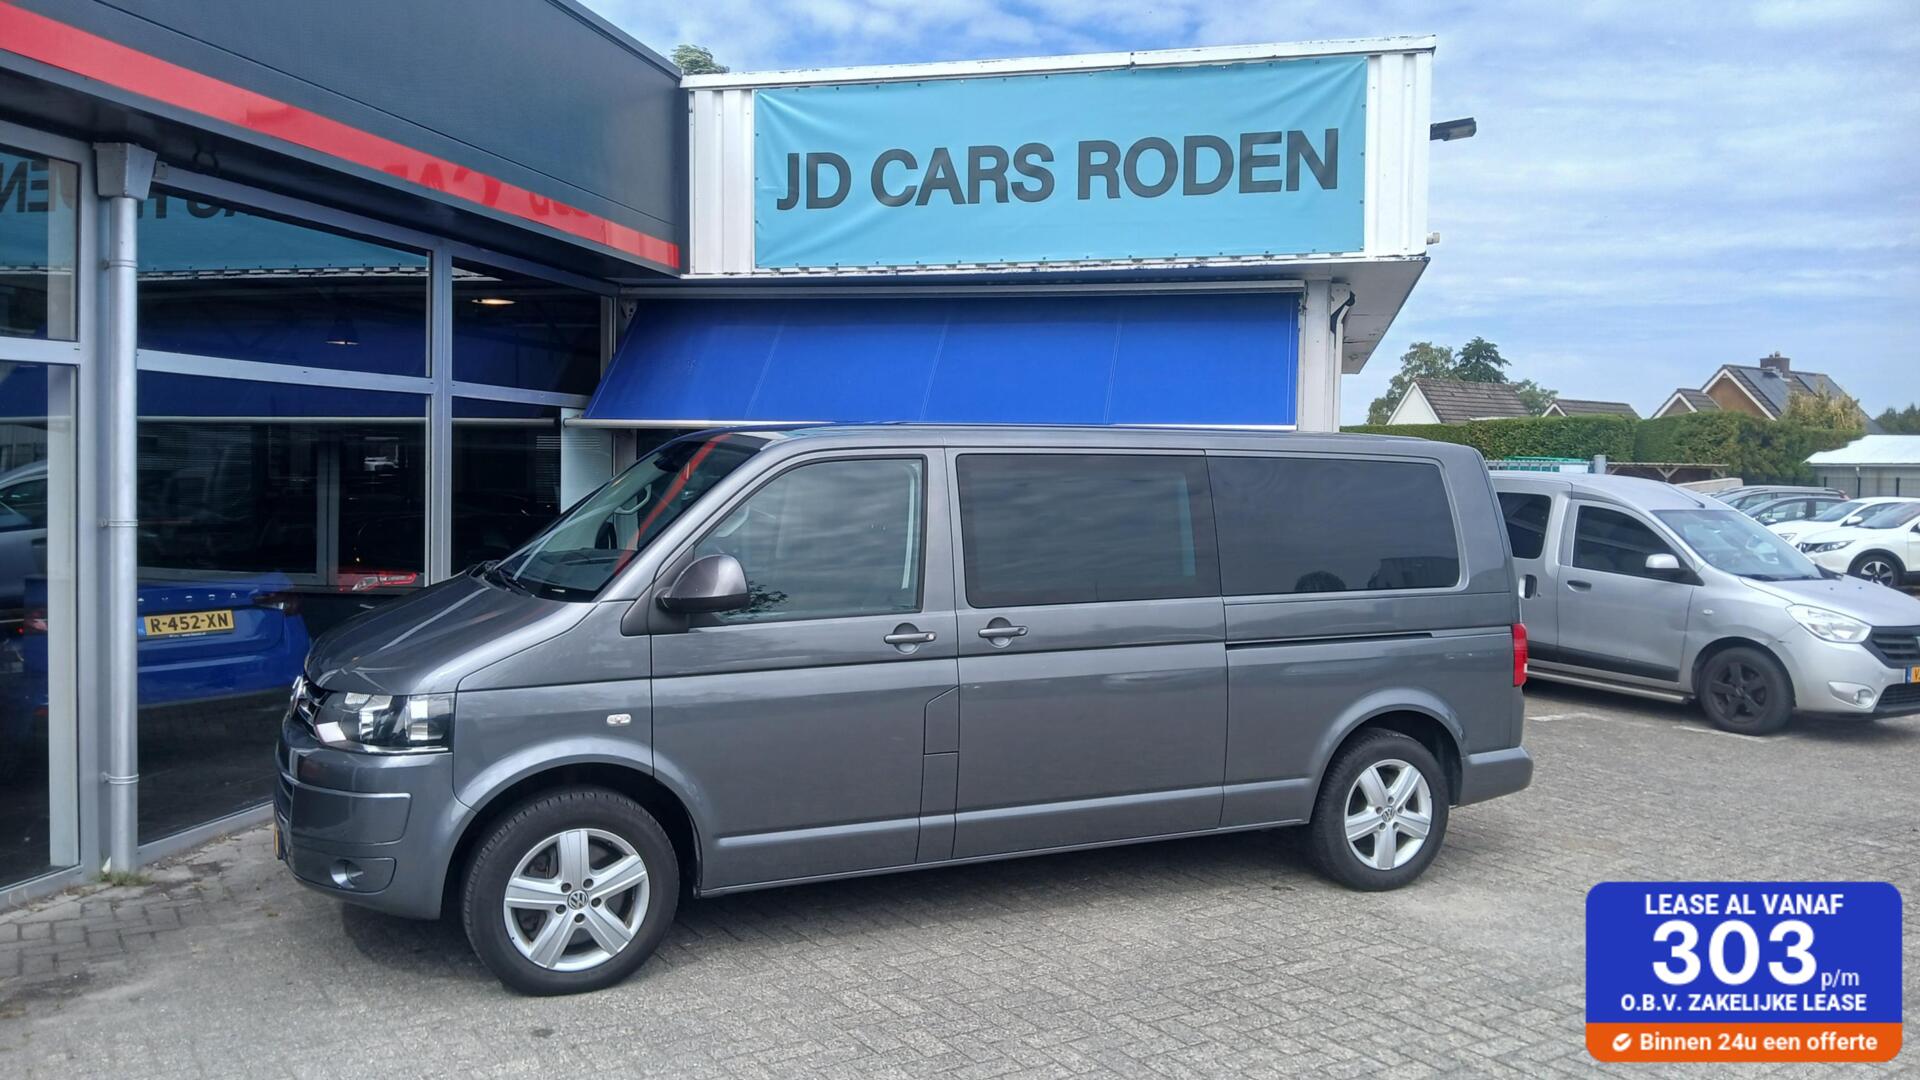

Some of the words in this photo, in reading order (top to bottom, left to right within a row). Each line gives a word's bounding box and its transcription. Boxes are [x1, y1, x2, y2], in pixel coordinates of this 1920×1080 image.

[777, 153, 851, 210] JD
[871, 143, 1055, 206] CARS
[1077, 129, 1338, 199] RODEN
[150, 613, 229, 632] R-452-XN
